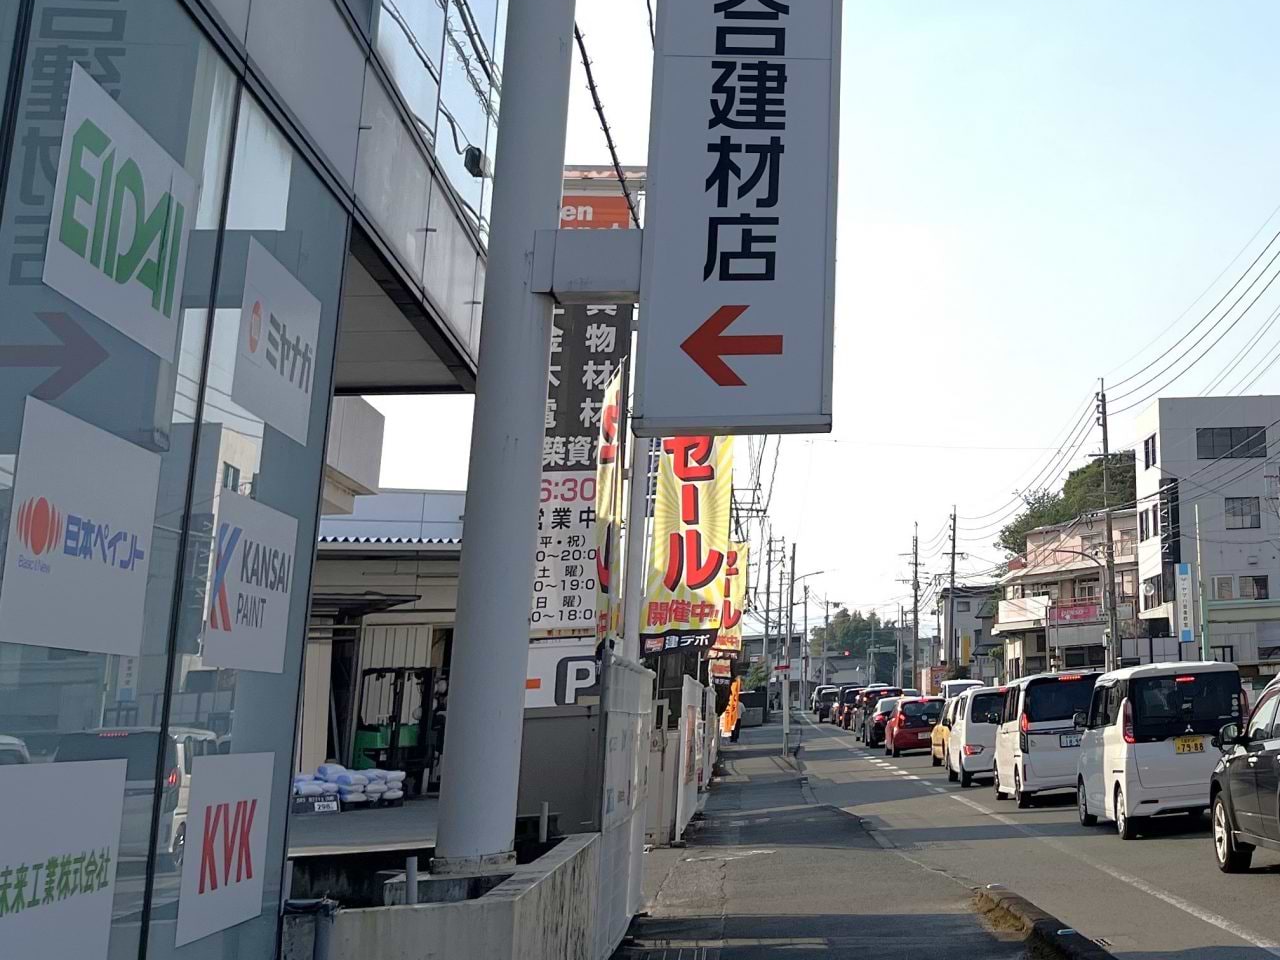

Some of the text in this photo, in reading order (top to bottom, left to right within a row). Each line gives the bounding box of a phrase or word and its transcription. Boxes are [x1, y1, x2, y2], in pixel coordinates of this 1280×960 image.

[59, 118, 185, 319] EIDAI
[265, 311, 313, 394] ミヤナガ
[543, 436, 601, 467] 築資
[64, 514, 145, 571] 日本ペイント
[663, 436, 724, 592] セール
[240, 539, 291, 594] KANSAI
[236, 593, 267, 628] PAINT
[665, 634, 710, 650] 建デポ
[564, 660, 596, 704] P
[198, 799, 258, 895] KVK
[0, 846, 110, 918] 未来工業株式会社
